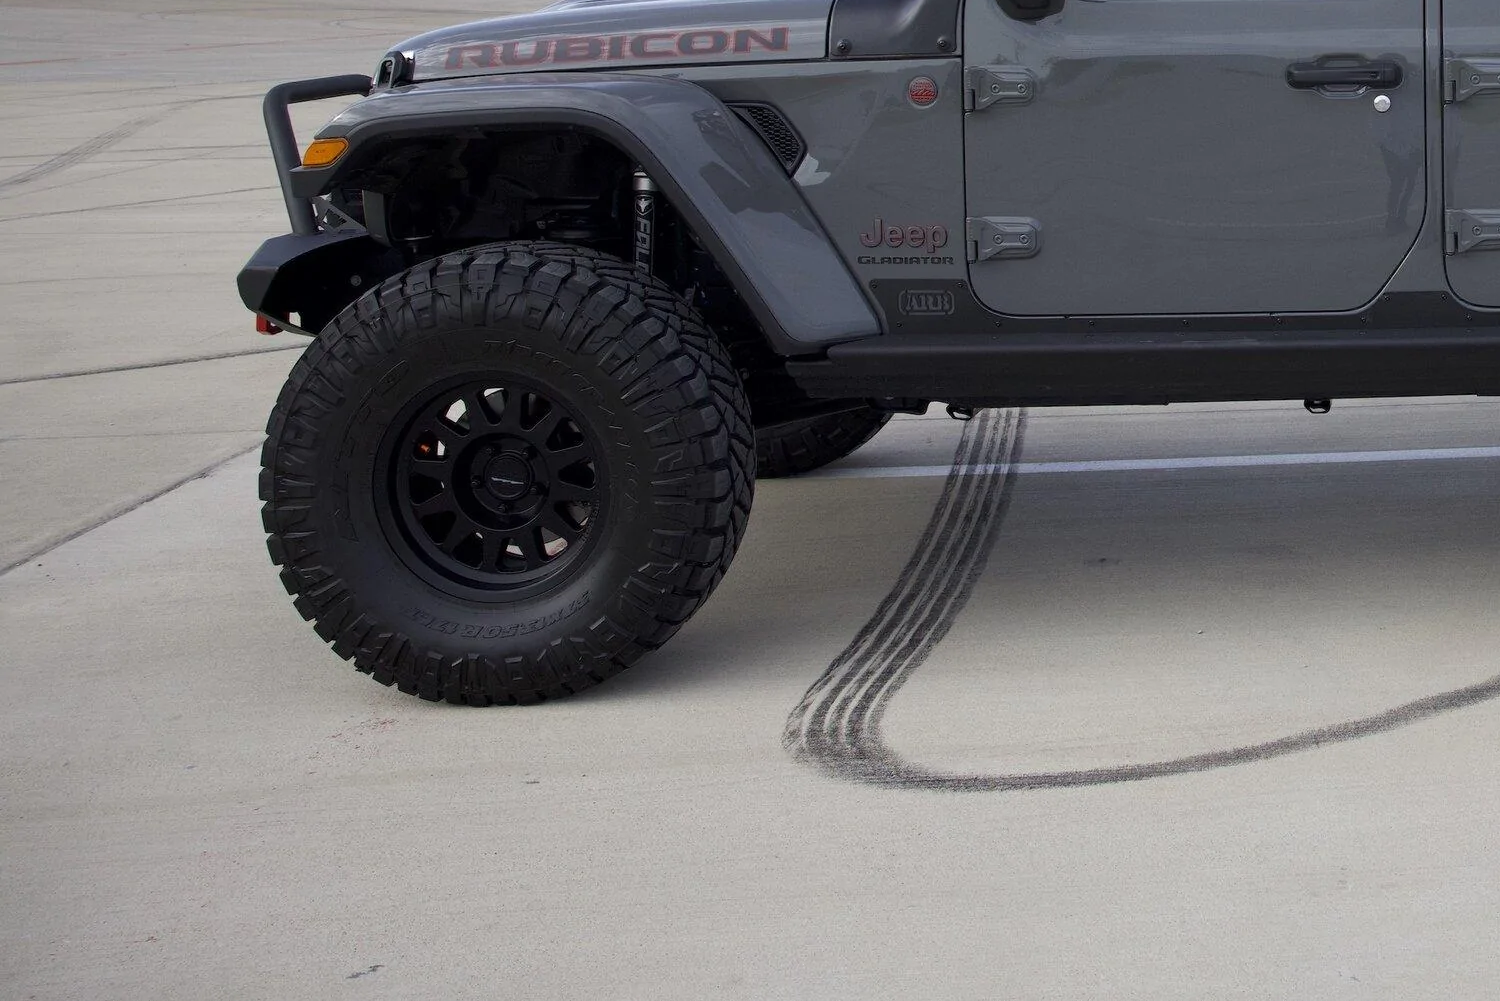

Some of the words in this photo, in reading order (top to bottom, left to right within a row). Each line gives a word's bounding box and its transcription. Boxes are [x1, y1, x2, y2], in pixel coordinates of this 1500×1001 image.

[444, 27, 790, 70] RUBICON
[635, 217, 651, 275] FALC
[860, 218, 948, 254] Jeep
[858, 256, 955, 265] GLADIATOR
[905, 294, 950, 311] ARB
